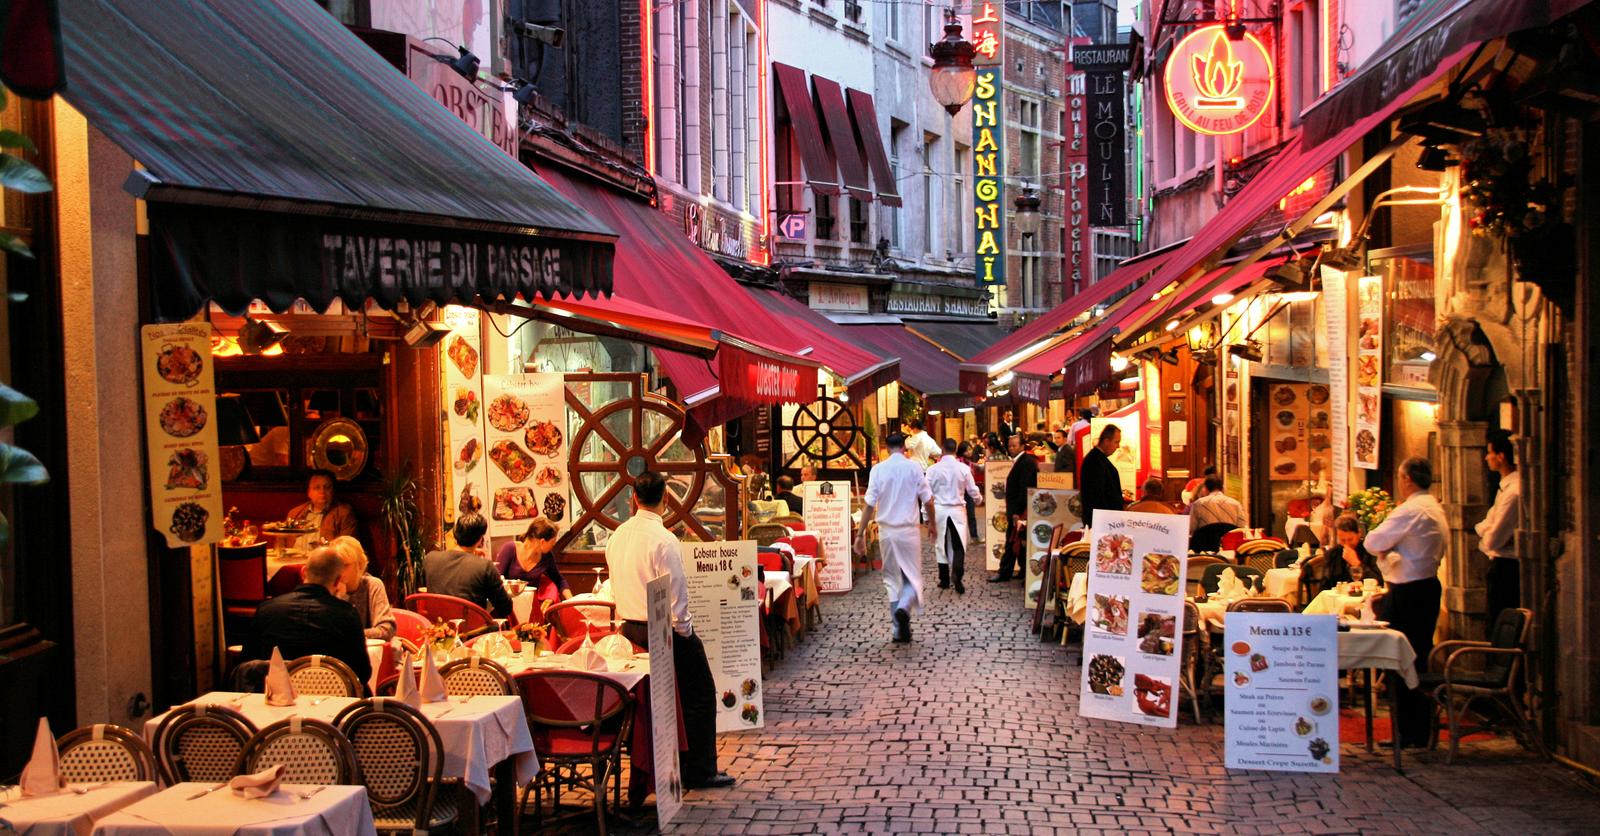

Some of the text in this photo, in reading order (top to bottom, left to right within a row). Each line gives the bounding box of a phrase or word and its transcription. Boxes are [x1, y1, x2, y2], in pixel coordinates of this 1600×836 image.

[973, 3, 999, 58] 上海
[1074, 49, 1129, 65] RESTAURAN
[1173, 89, 1266, 131] GRILL AU FEU DE BOIS
[433, 83, 514, 158] OBSTER
[1095, 101, 1117, 224] MOULIN
[789, 219, 805, 237] P
[322, 233, 561, 291] TAVERNE DU PASSAGE
[887, 295, 941, 313] RESTAURANT
[1108, 521, 1125, 531] Nos
[693, 546, 738, 559] Lobster house
[696, 561, 713, 573] Menu
[719, 560, 727, 571] 18
[728, 560, 733, 571] €
[1249, 624, 1312, 637] Menu à 13 €
[1237, 758, 1266, 766] Dessert
